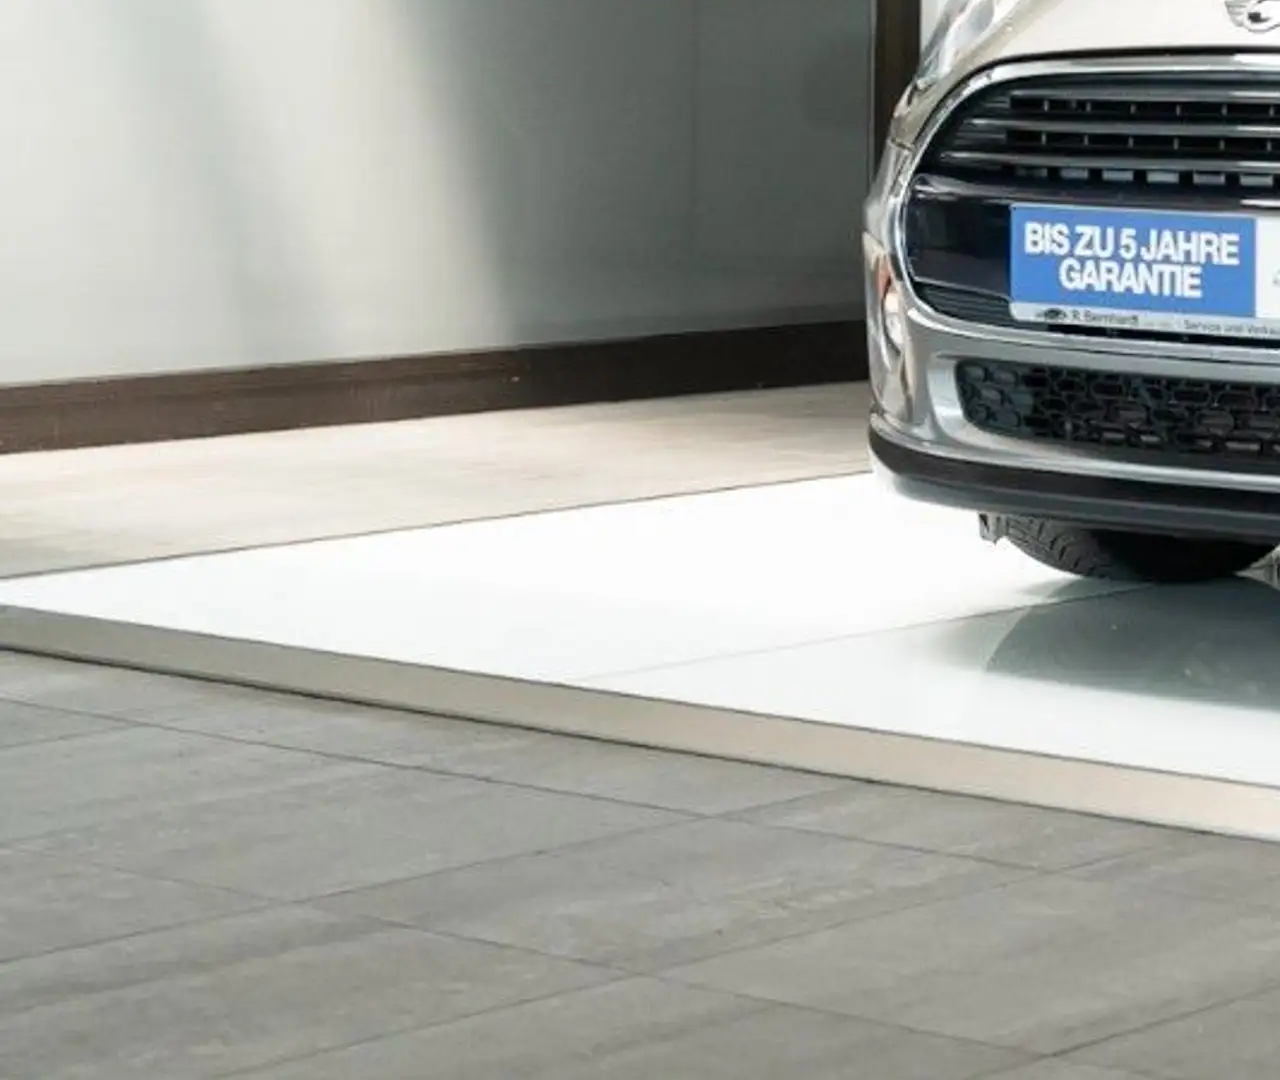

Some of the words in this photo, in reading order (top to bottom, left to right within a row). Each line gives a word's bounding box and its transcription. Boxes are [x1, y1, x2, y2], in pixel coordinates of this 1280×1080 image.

[1025, 223, 1070, 255] BIS
[1074, 225, 1114, 258] ZU
[1119, 228, 1137, 260] 5
[1141, 229, 1240, 266] JAHRE
[1060, 257, 1202, 298] GARANTIE
